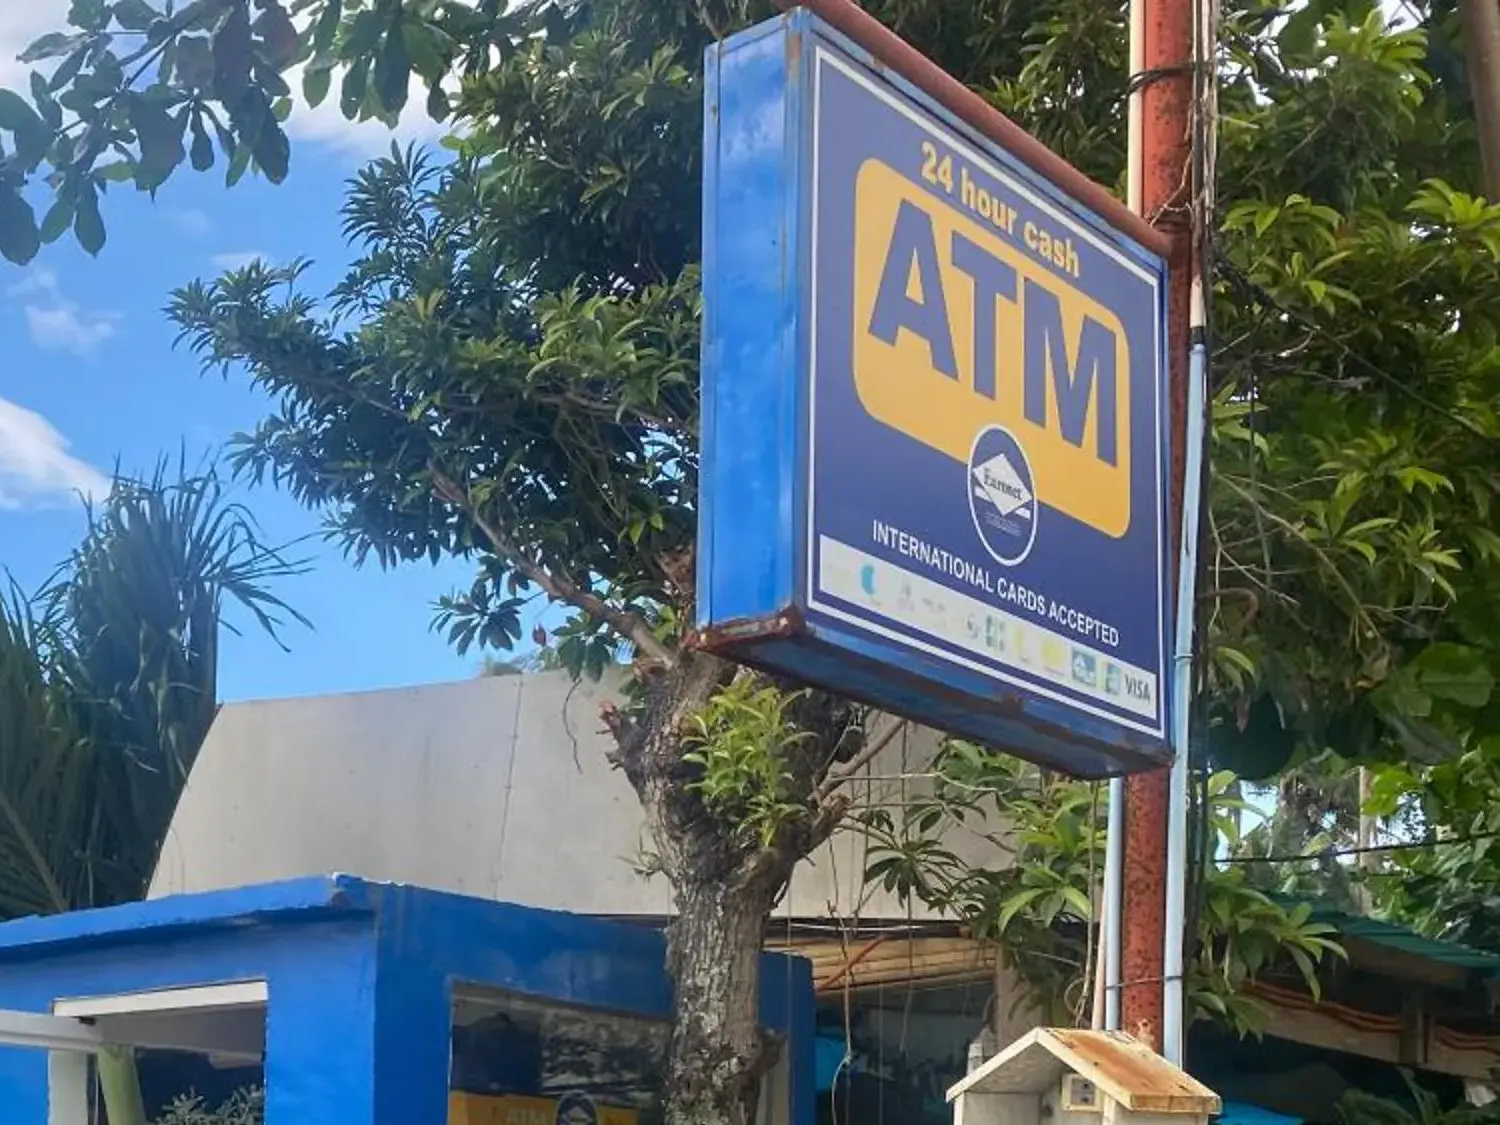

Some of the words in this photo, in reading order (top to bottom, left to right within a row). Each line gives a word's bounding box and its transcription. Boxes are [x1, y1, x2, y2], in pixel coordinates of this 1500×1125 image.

[919, 140, 954, 195] 24
[961, 165, 1018, 236] hour
[1023, 219, 1080, 278] cash
[868, 197, 1117, 468] ATM
[872, 519, 995, 594] INTERNATIONAL
[997, 577, 1047, 616] CARDS
[1049, 600, 1120, 647] ACCEPTED
[1123, 672, 1152, 702] VISA
